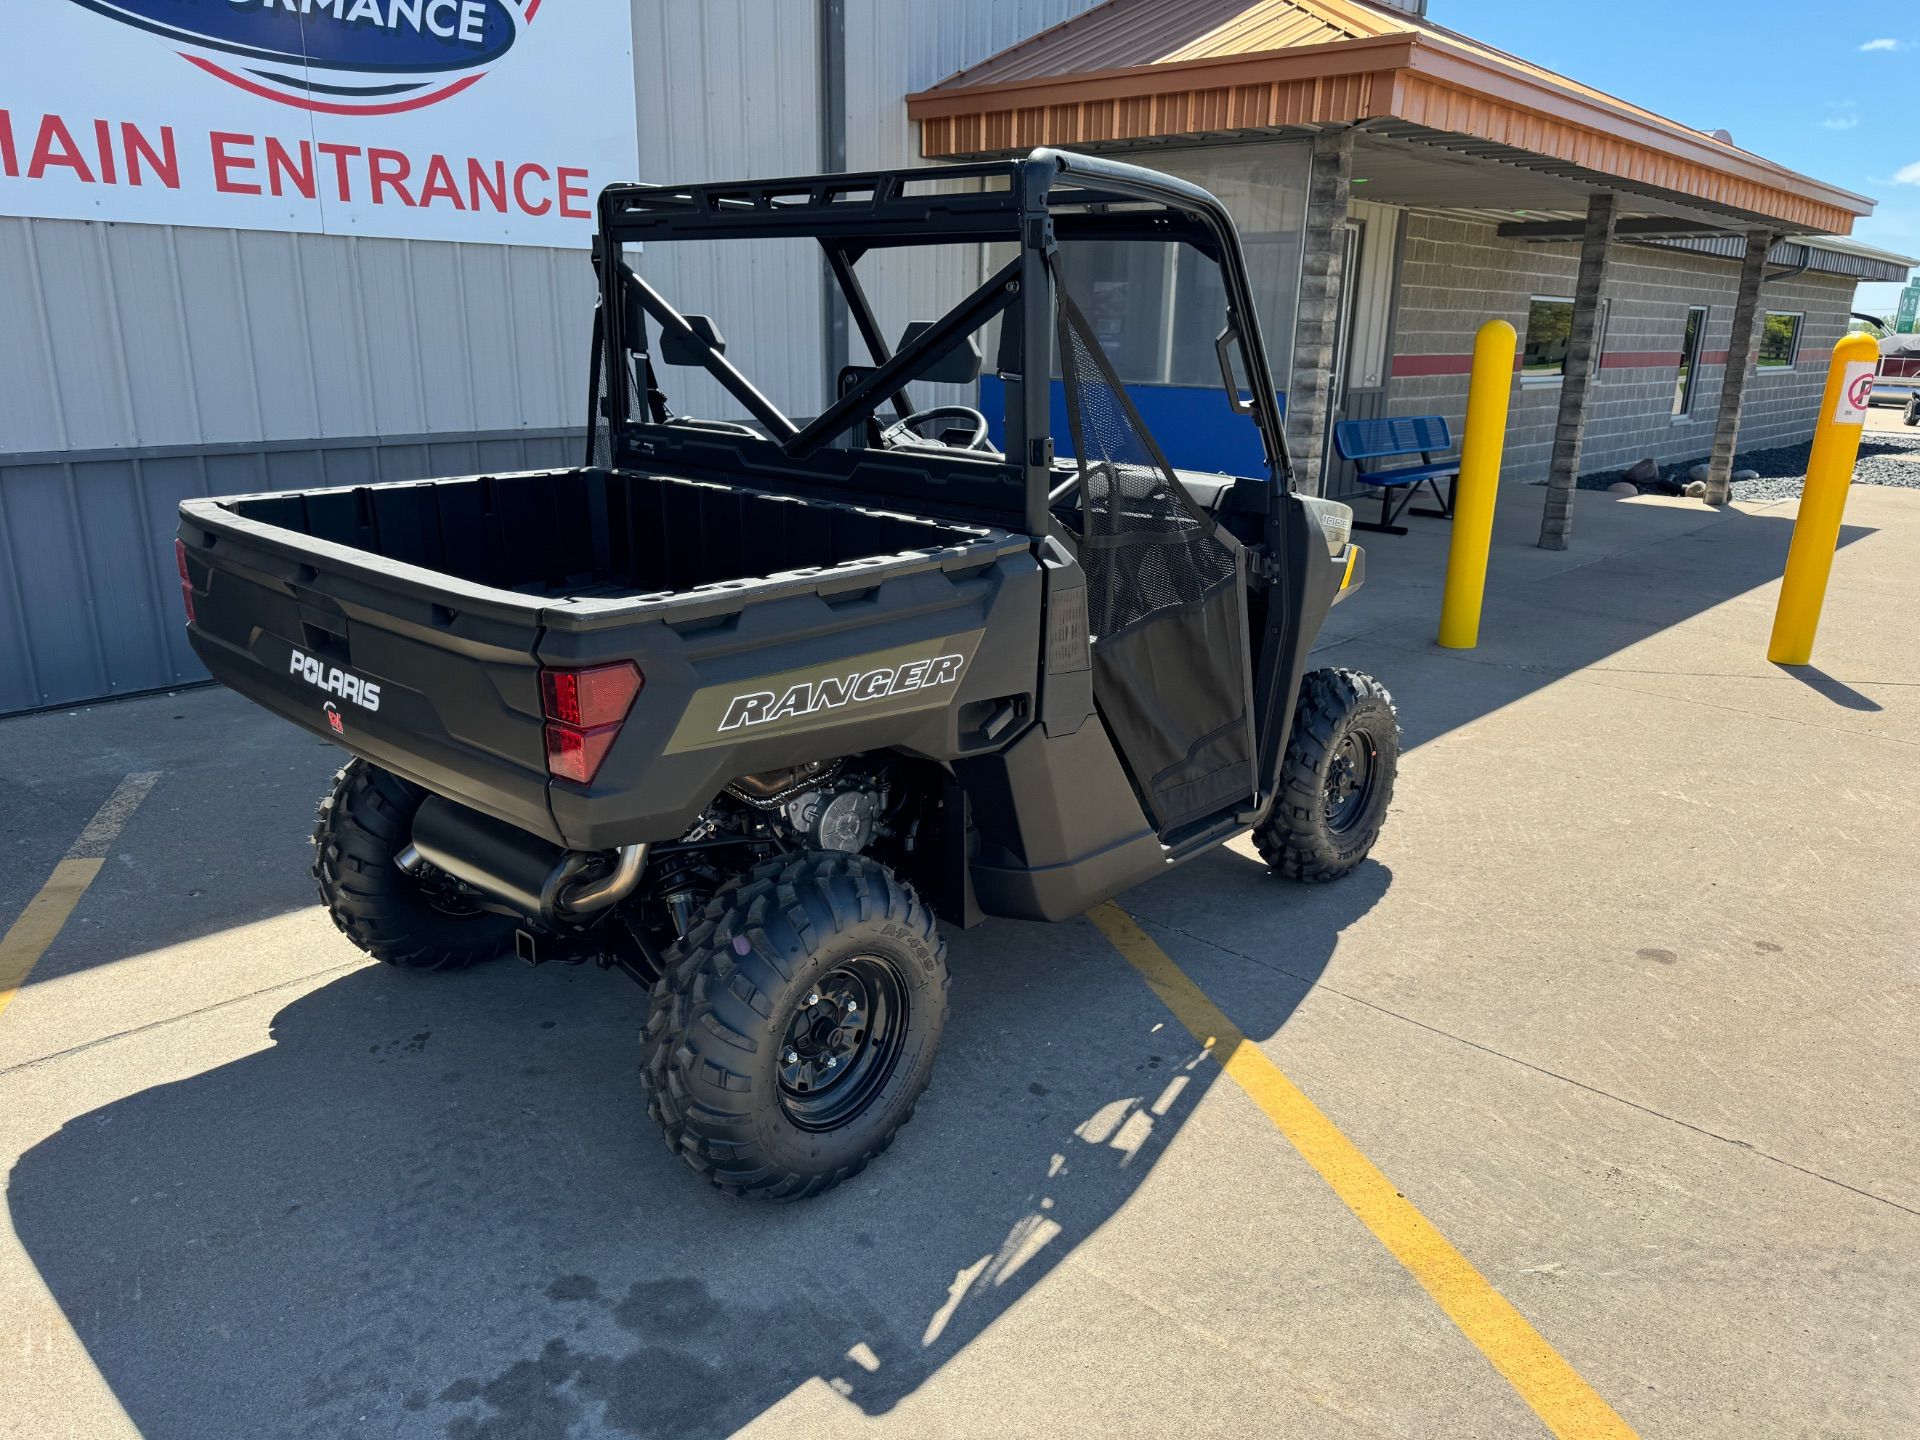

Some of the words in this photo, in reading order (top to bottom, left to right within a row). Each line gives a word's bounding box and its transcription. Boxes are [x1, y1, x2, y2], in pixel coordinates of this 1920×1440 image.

[226, 0, 486, 43] ANCE
[209, 130, 592, 219] ENTRANCE
[290, 649, 380, 712] POLARIS
[718, 653, 964, 731] RANGER
